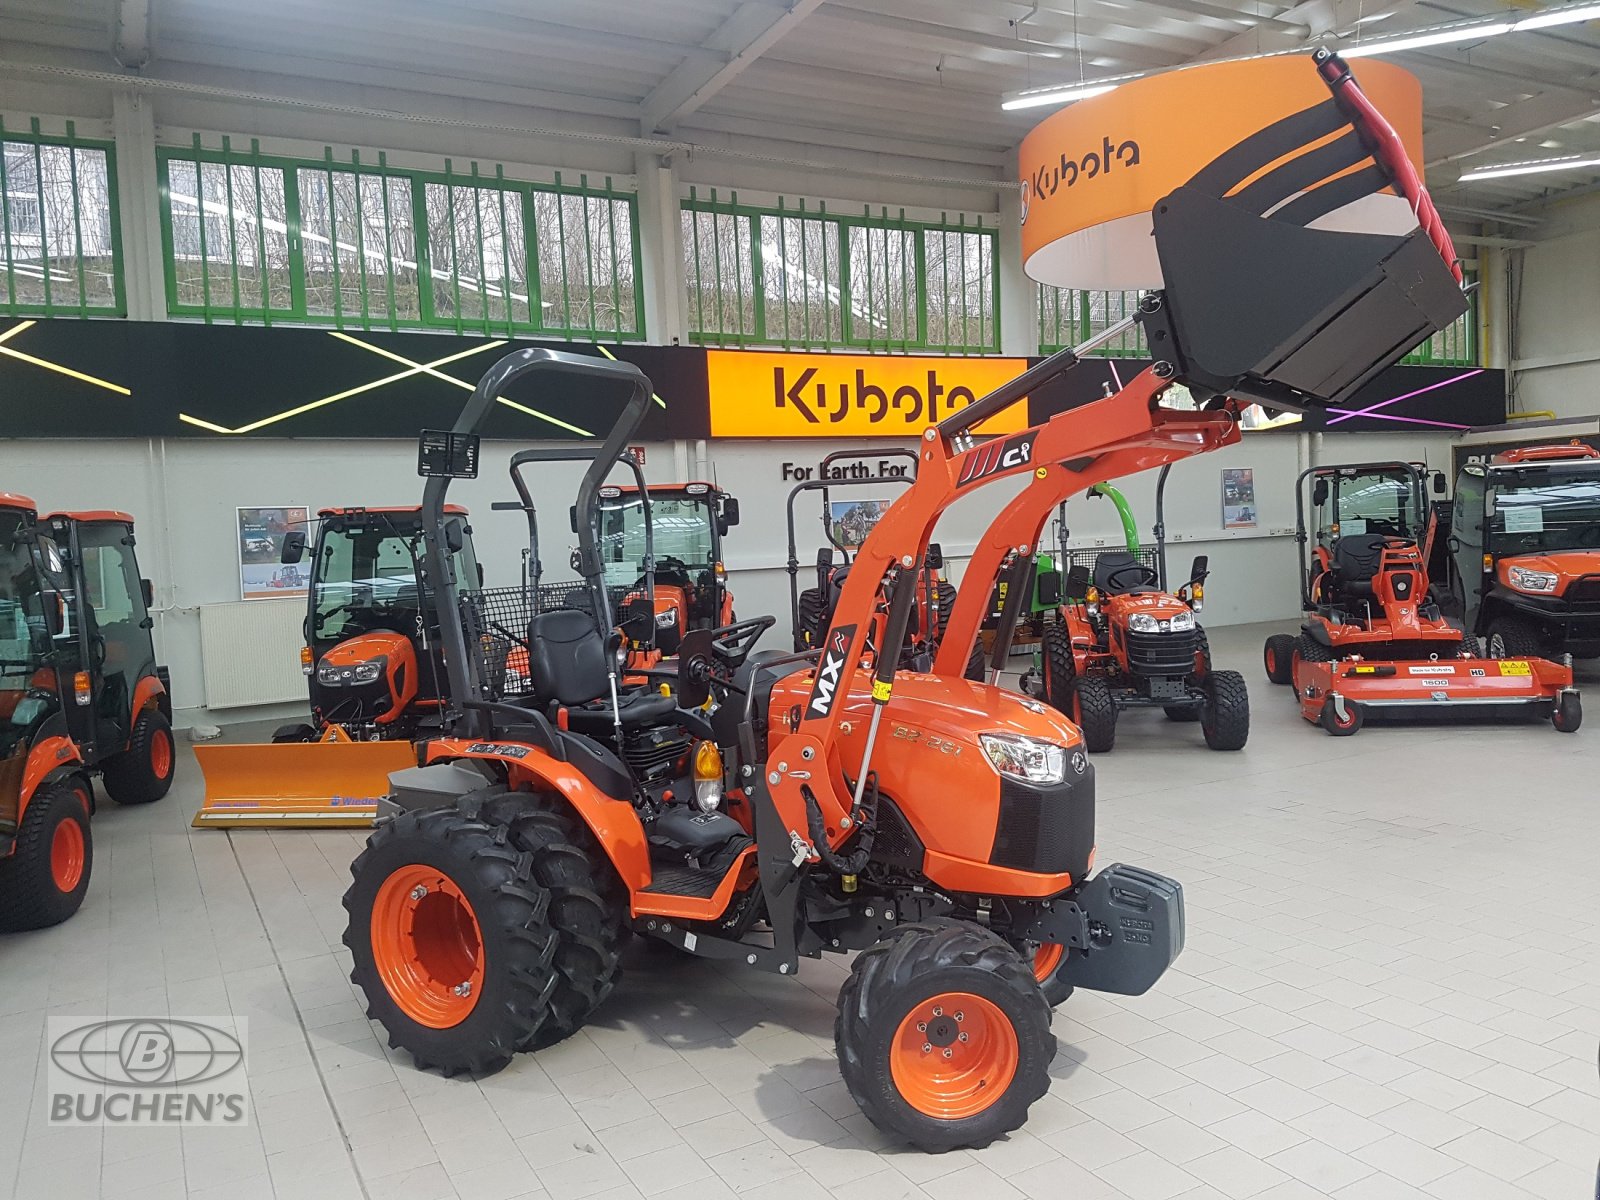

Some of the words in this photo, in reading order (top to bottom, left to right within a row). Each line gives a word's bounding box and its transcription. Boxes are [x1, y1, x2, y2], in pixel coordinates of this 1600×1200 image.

[1032, 136, 1140, 201] Kubota
[782, 463, 813, 481] For
[879, 461, 908, 478] For
[811, 650, 844, 715] MX
